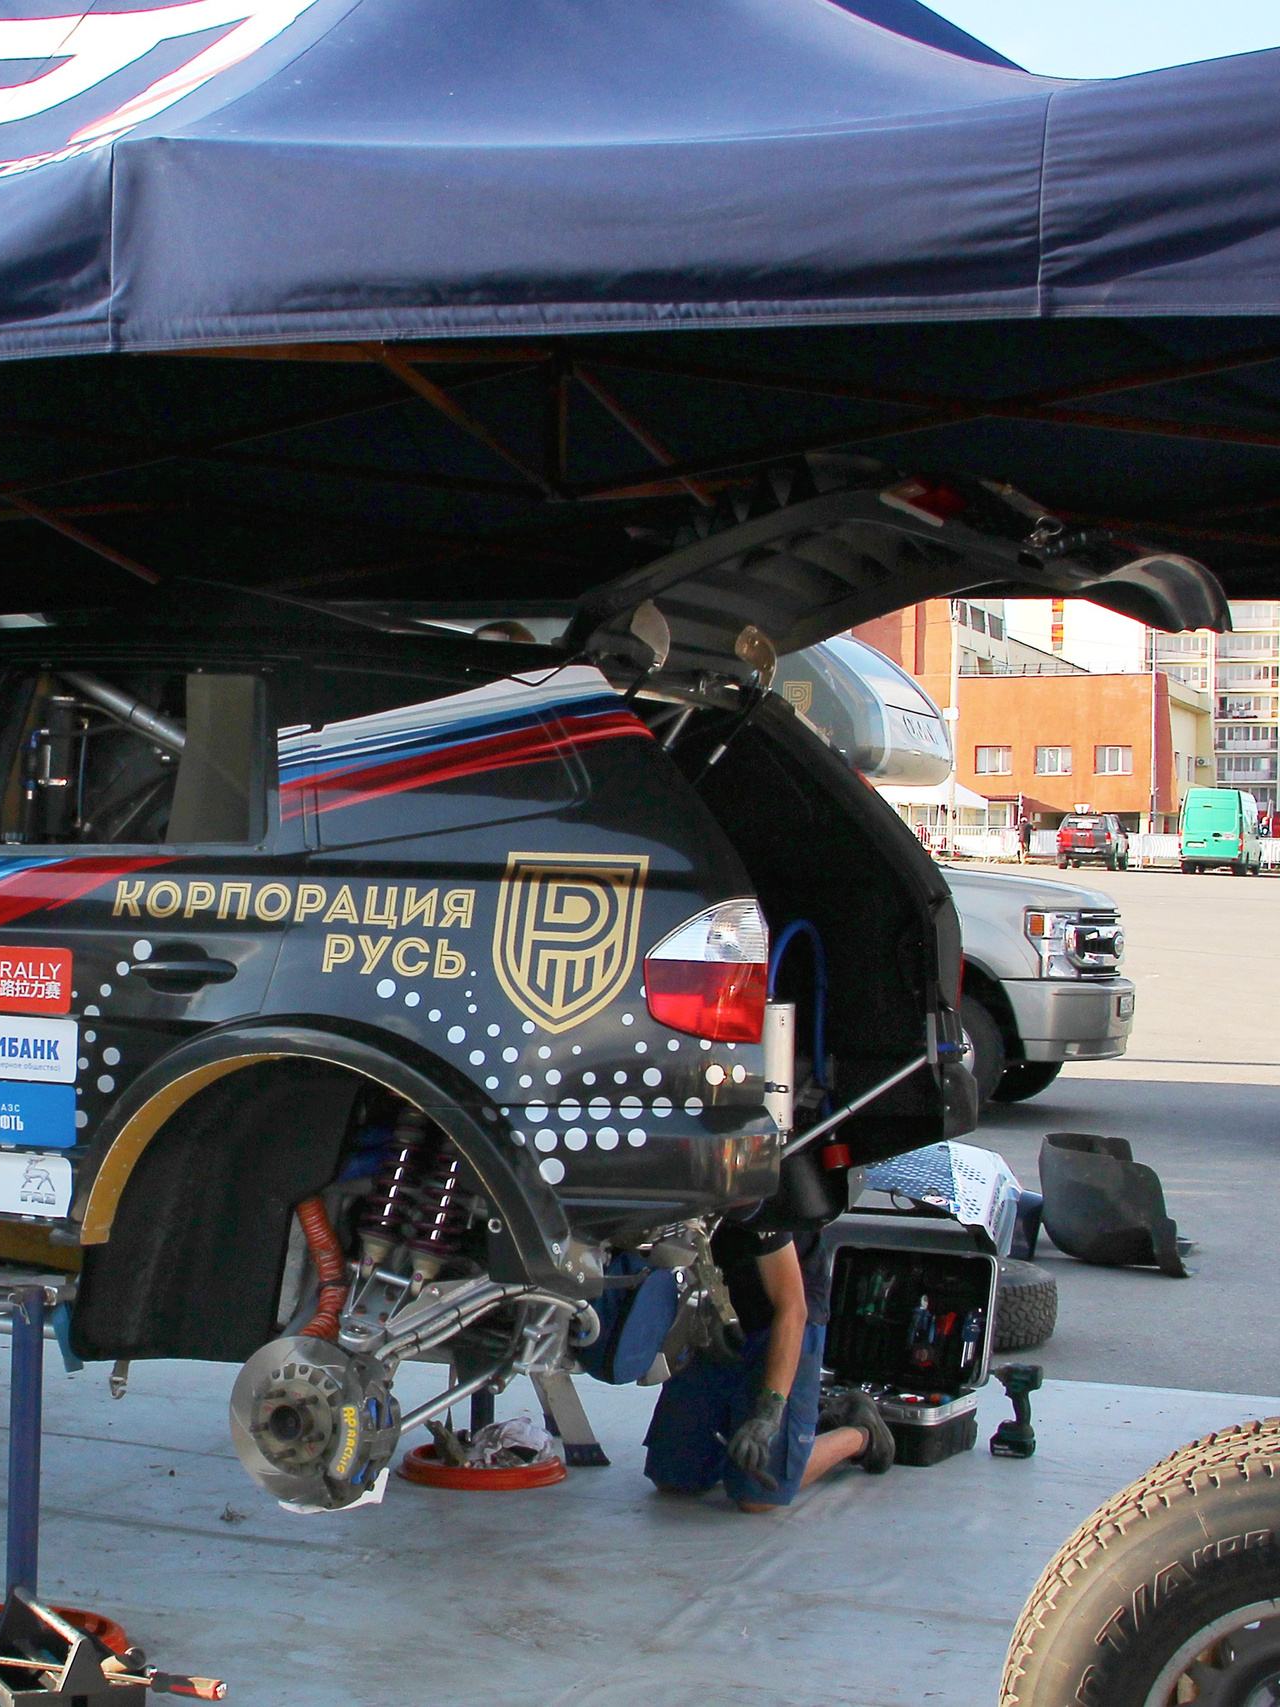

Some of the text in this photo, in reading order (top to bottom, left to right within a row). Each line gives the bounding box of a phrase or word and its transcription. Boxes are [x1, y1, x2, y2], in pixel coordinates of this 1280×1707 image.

[112, 880, 475, 929] КОРПОРАЦИЯ
[0, 961, 62, 980] RALLY
[322, 936, 467, 979] РУСЬ
[1, 1104, 21, 1113] АЗС
